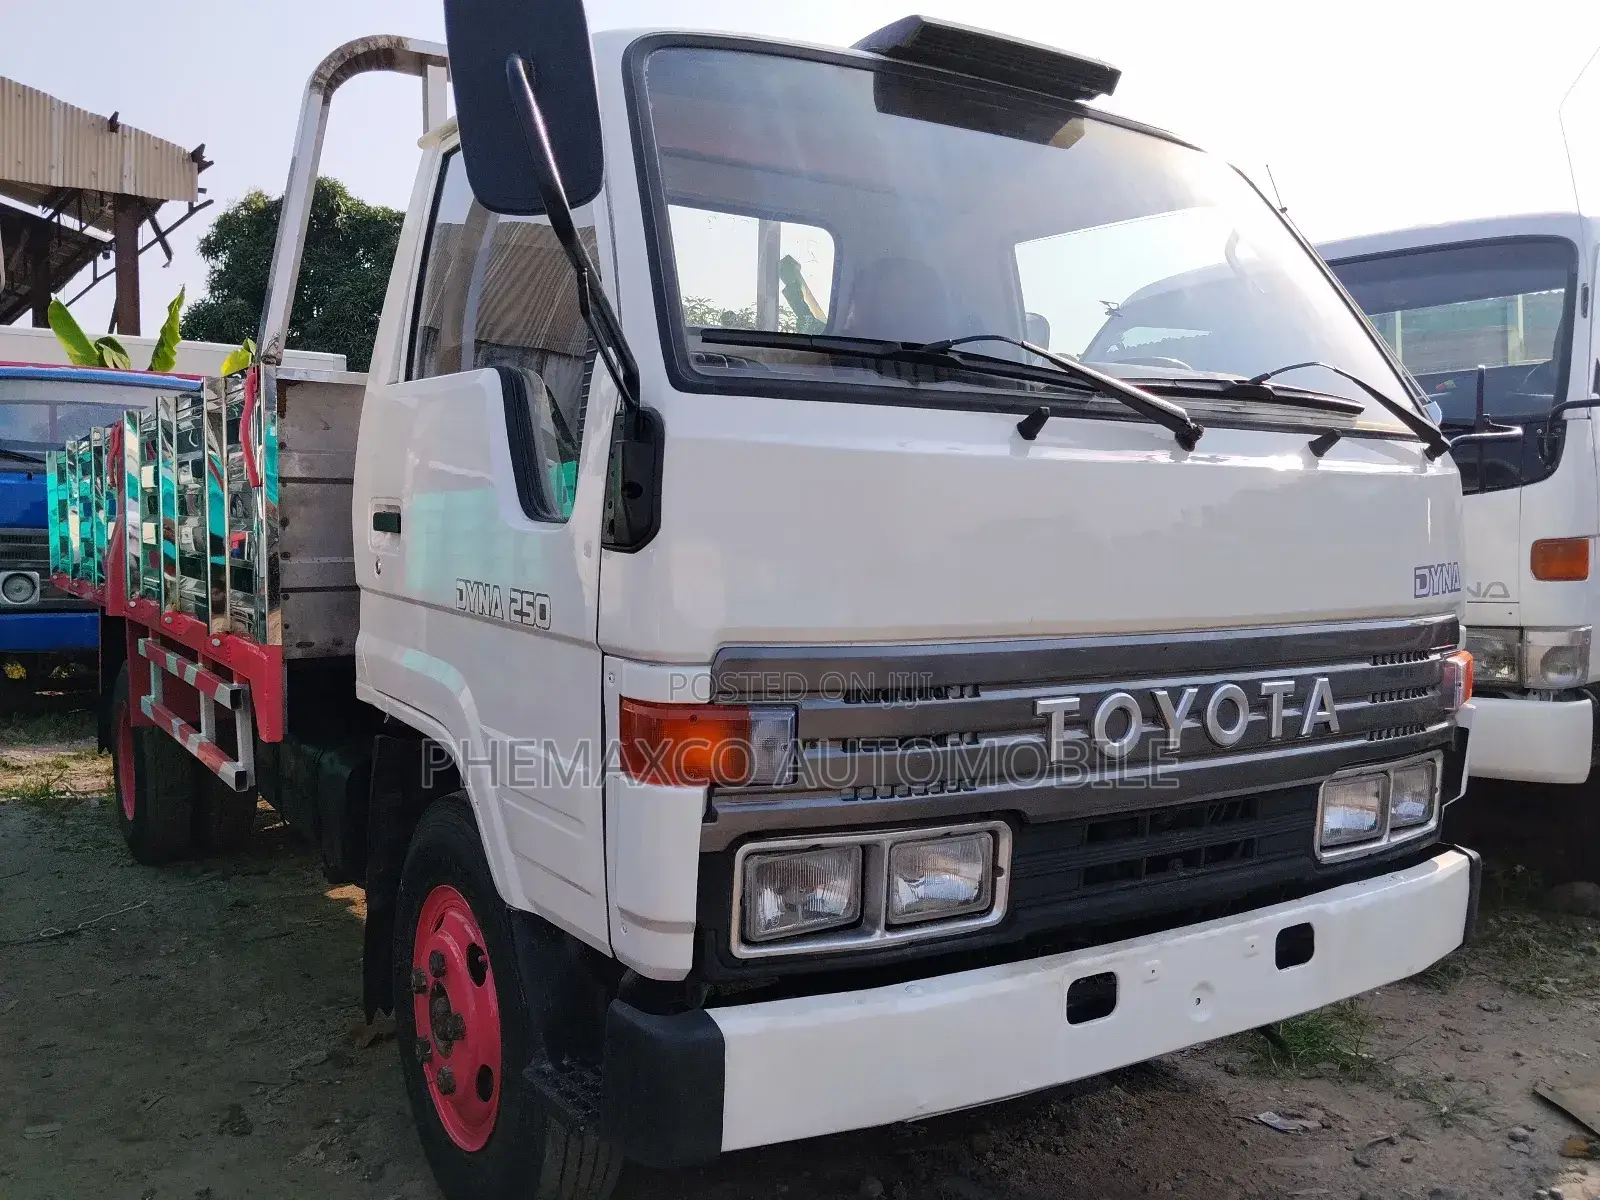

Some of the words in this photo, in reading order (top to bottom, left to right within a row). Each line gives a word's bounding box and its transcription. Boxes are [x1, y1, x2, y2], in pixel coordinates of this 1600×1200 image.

[455, 577, 504, 619] DYNA
[509, 587, 551, 630] 250
[1413, 562, 1461, 599] DYNA
[1034, 677, 1341, 766] TOYOTA
